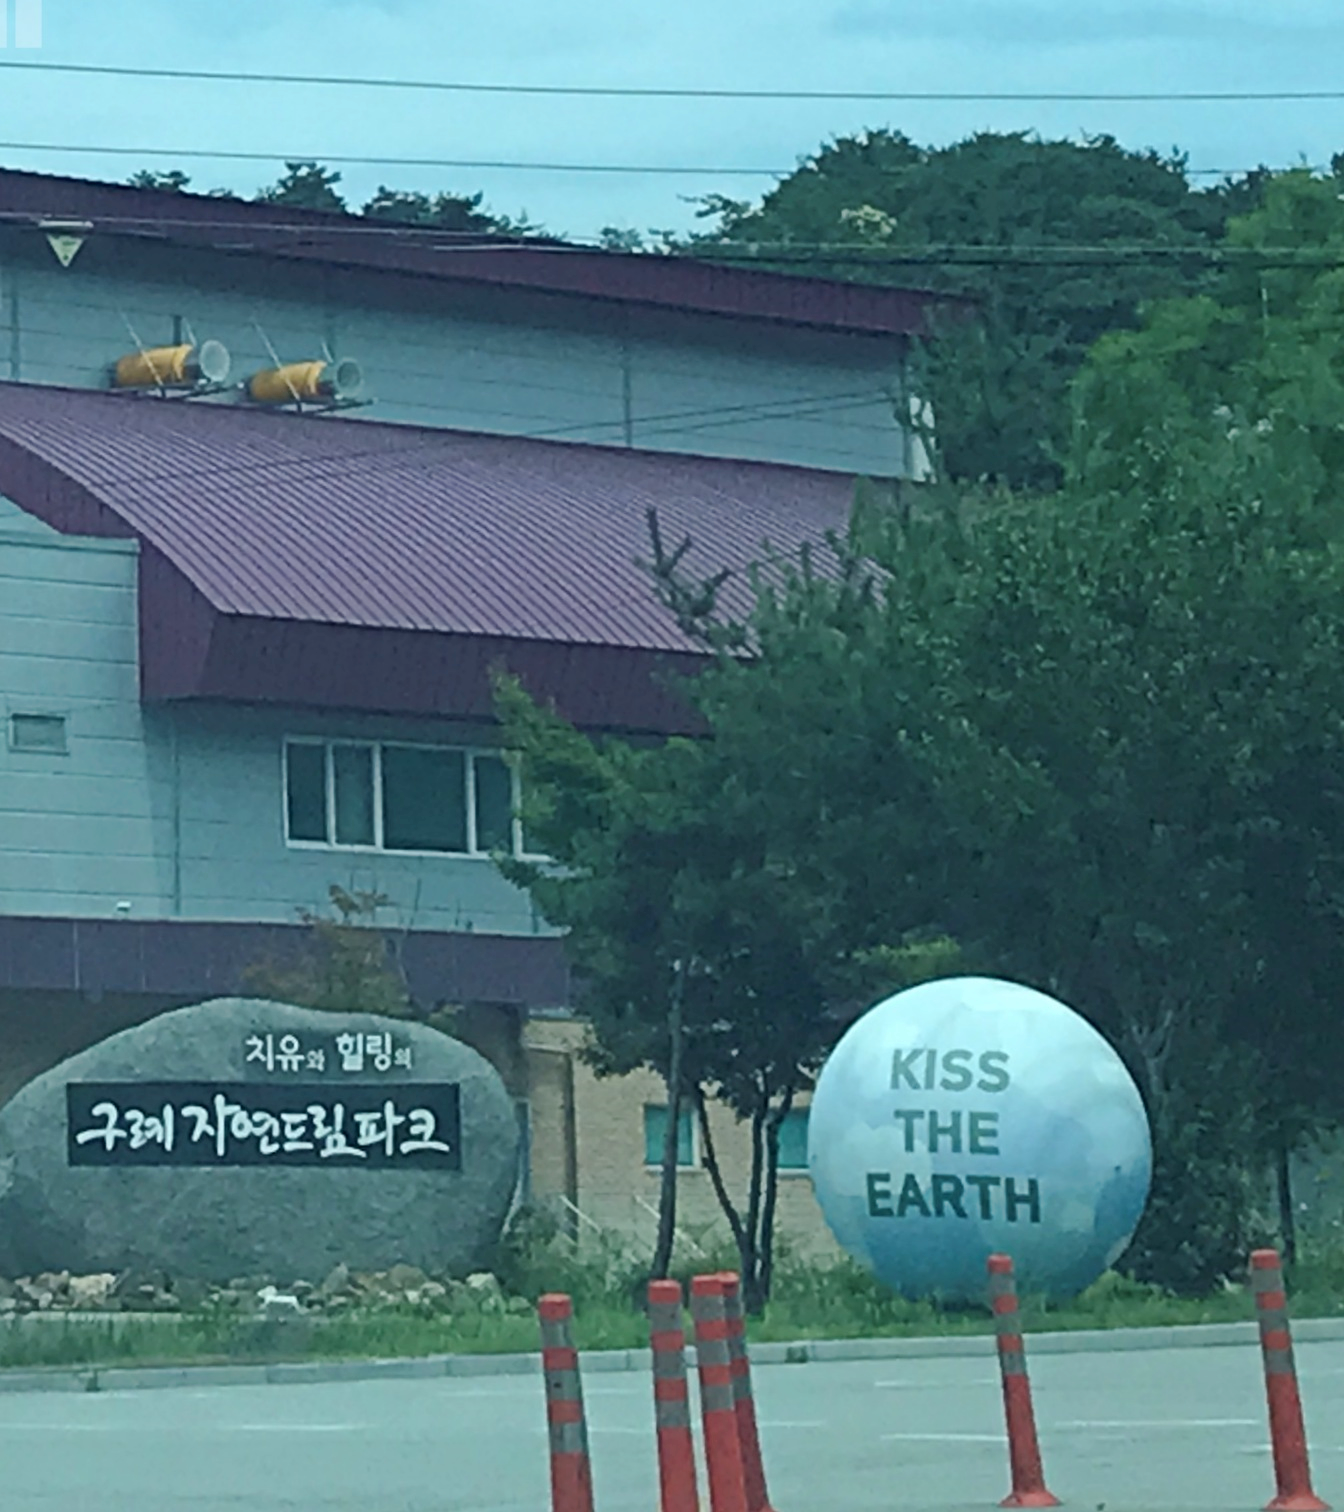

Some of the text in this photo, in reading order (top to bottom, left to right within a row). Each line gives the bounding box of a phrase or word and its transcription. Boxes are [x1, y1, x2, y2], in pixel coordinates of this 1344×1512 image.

[244, 1032, 412, 1072] 치유와 힐링의
[889, 1048, 1011, 1093] KISS
[893, 1109, 1000, 1156] THE
[865, 1172, 1042, 1224] EARTH
